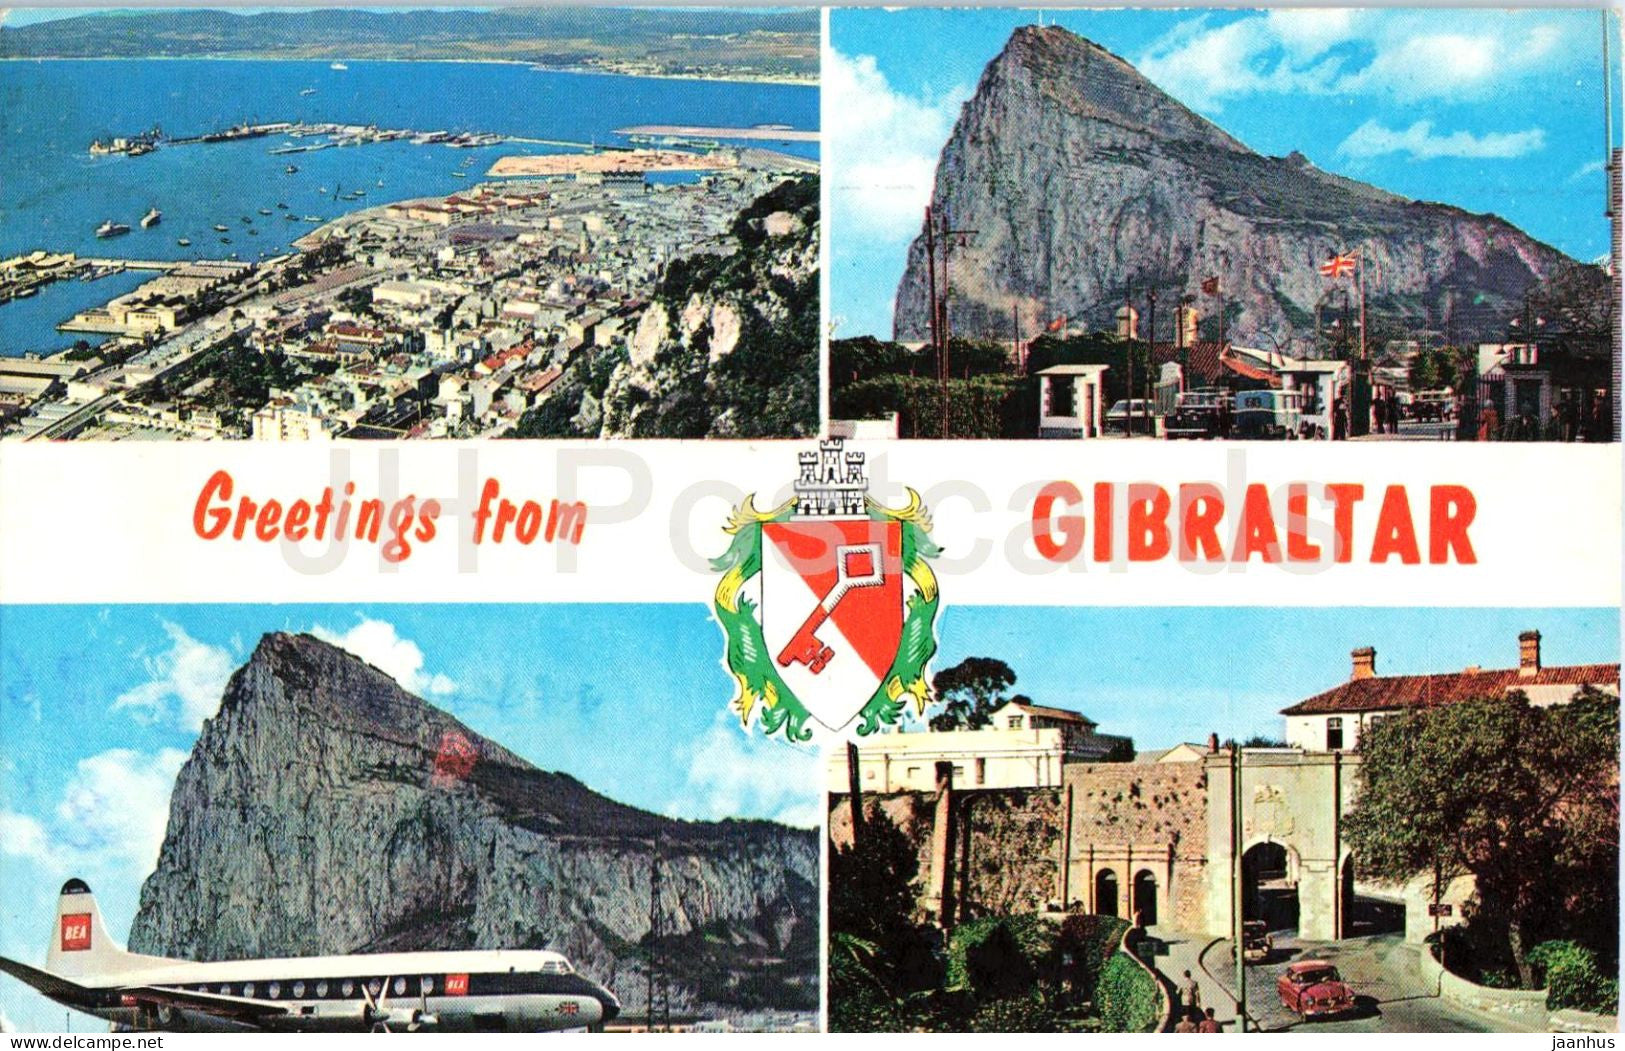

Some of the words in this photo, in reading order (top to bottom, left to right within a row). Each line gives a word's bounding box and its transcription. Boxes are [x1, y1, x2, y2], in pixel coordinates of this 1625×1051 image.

[192, 469, 440, 562] Greetings
[473, 477, 587, 544] from
[1031, 480, 1478, 565] GIBRALTAR
[65, 925, 87, 941] BEA
